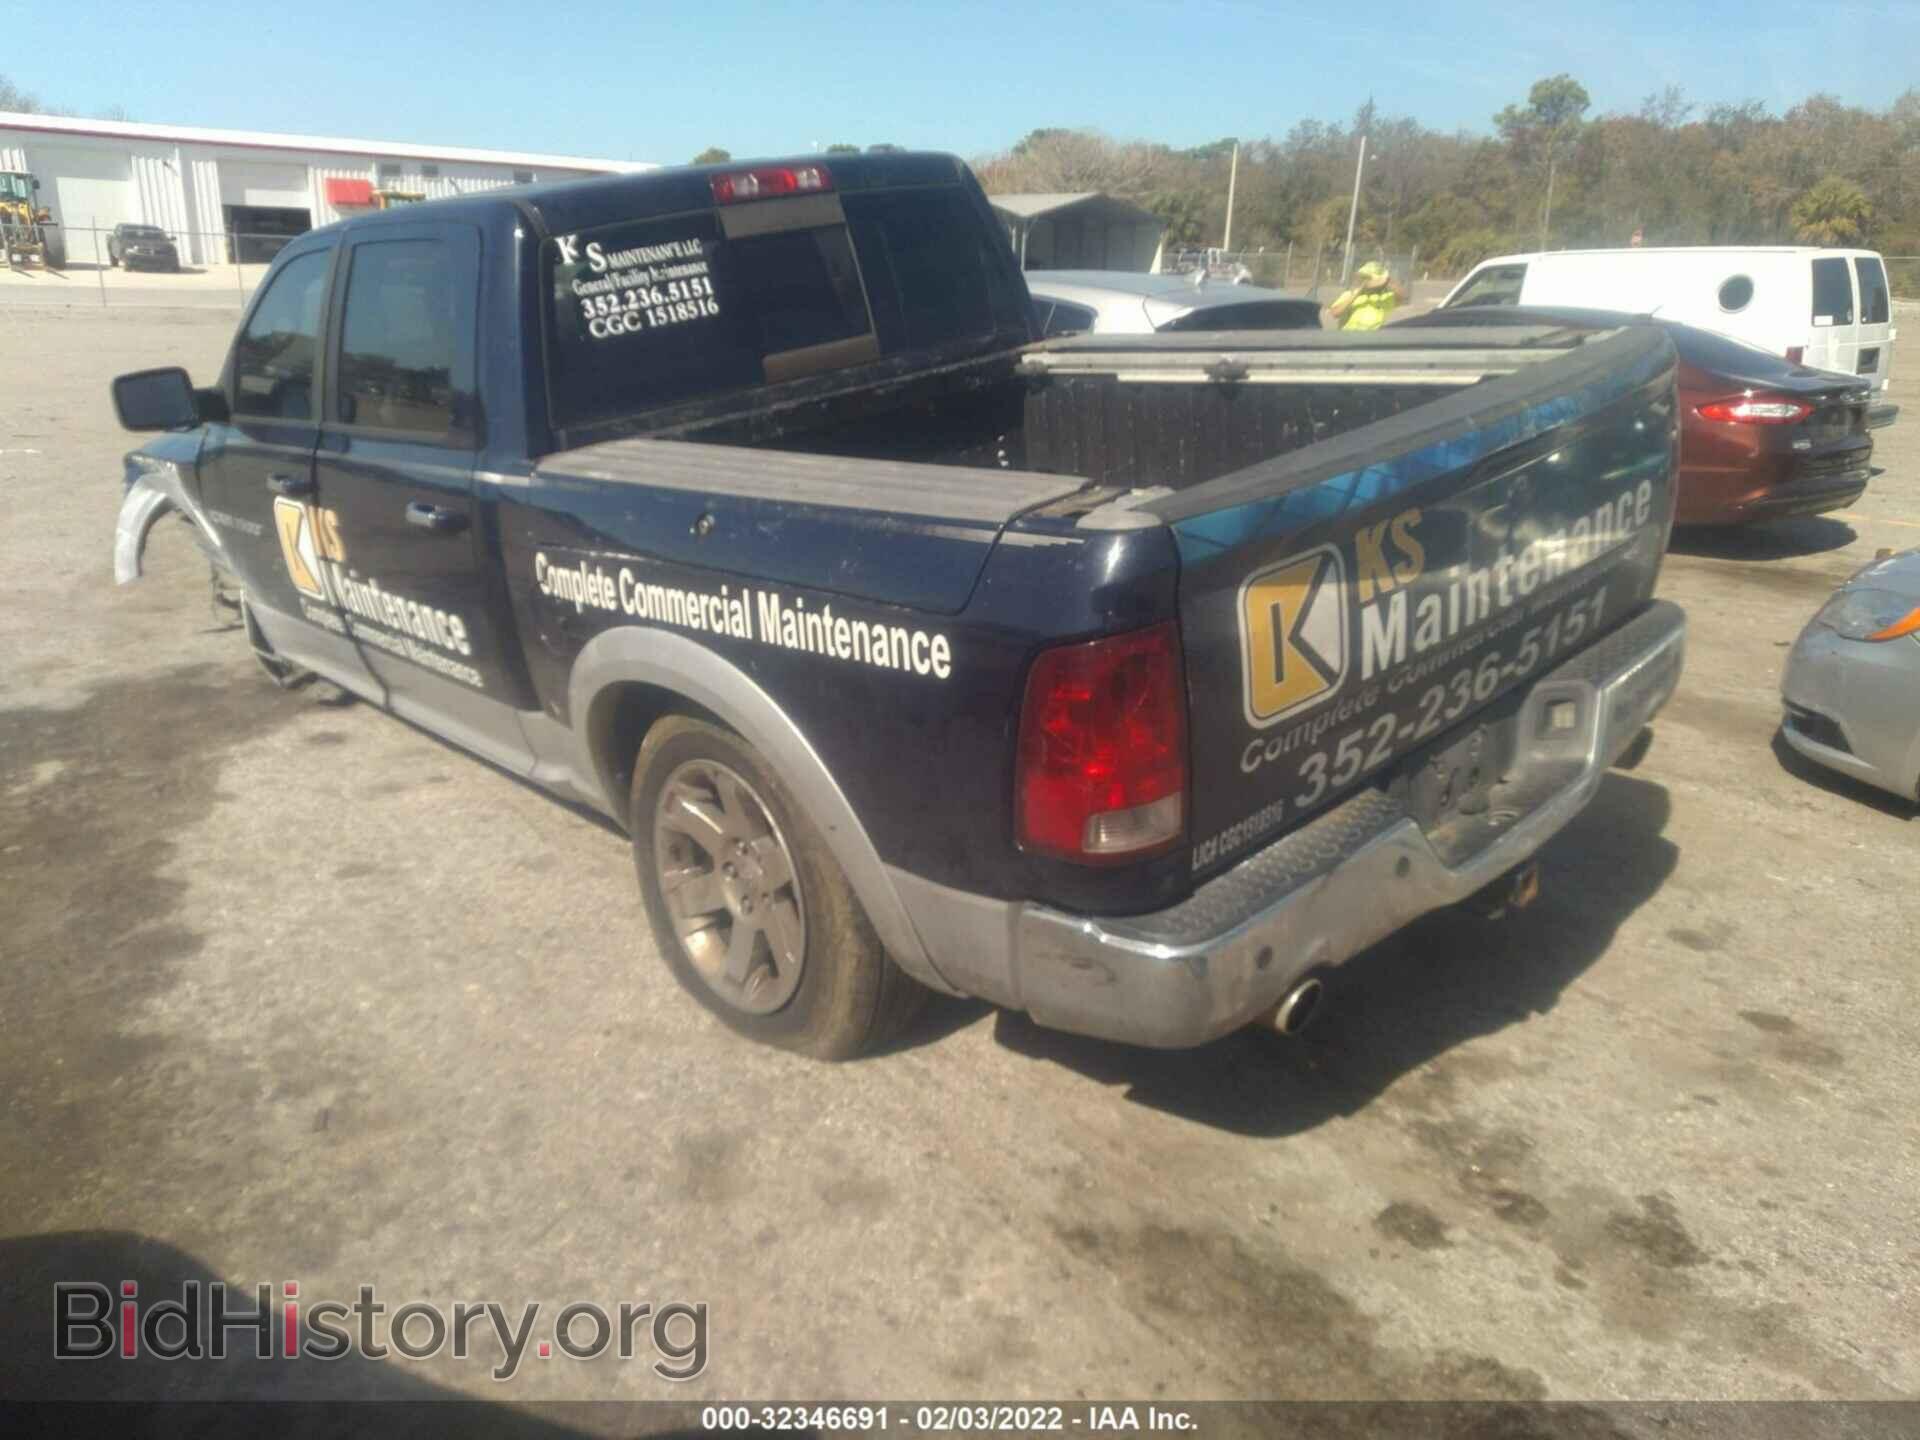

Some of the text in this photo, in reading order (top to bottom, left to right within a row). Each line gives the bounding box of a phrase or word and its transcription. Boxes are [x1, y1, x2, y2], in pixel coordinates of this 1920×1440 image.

[555, 234, 580, 265] K
[580, 276, 714, 320] 352.236.5151
[589, 297, 720, 338] CGC 1518516
[1354, 508, 1425, 603] KS
[1360, 478, 1653, 682] Maintenance
[534, 551, 951, 680] Complete Commercial Maintenance
[1239, 685, 1382, 773] Complete
[1293, 586, 1608, 807] 352-236-5151
